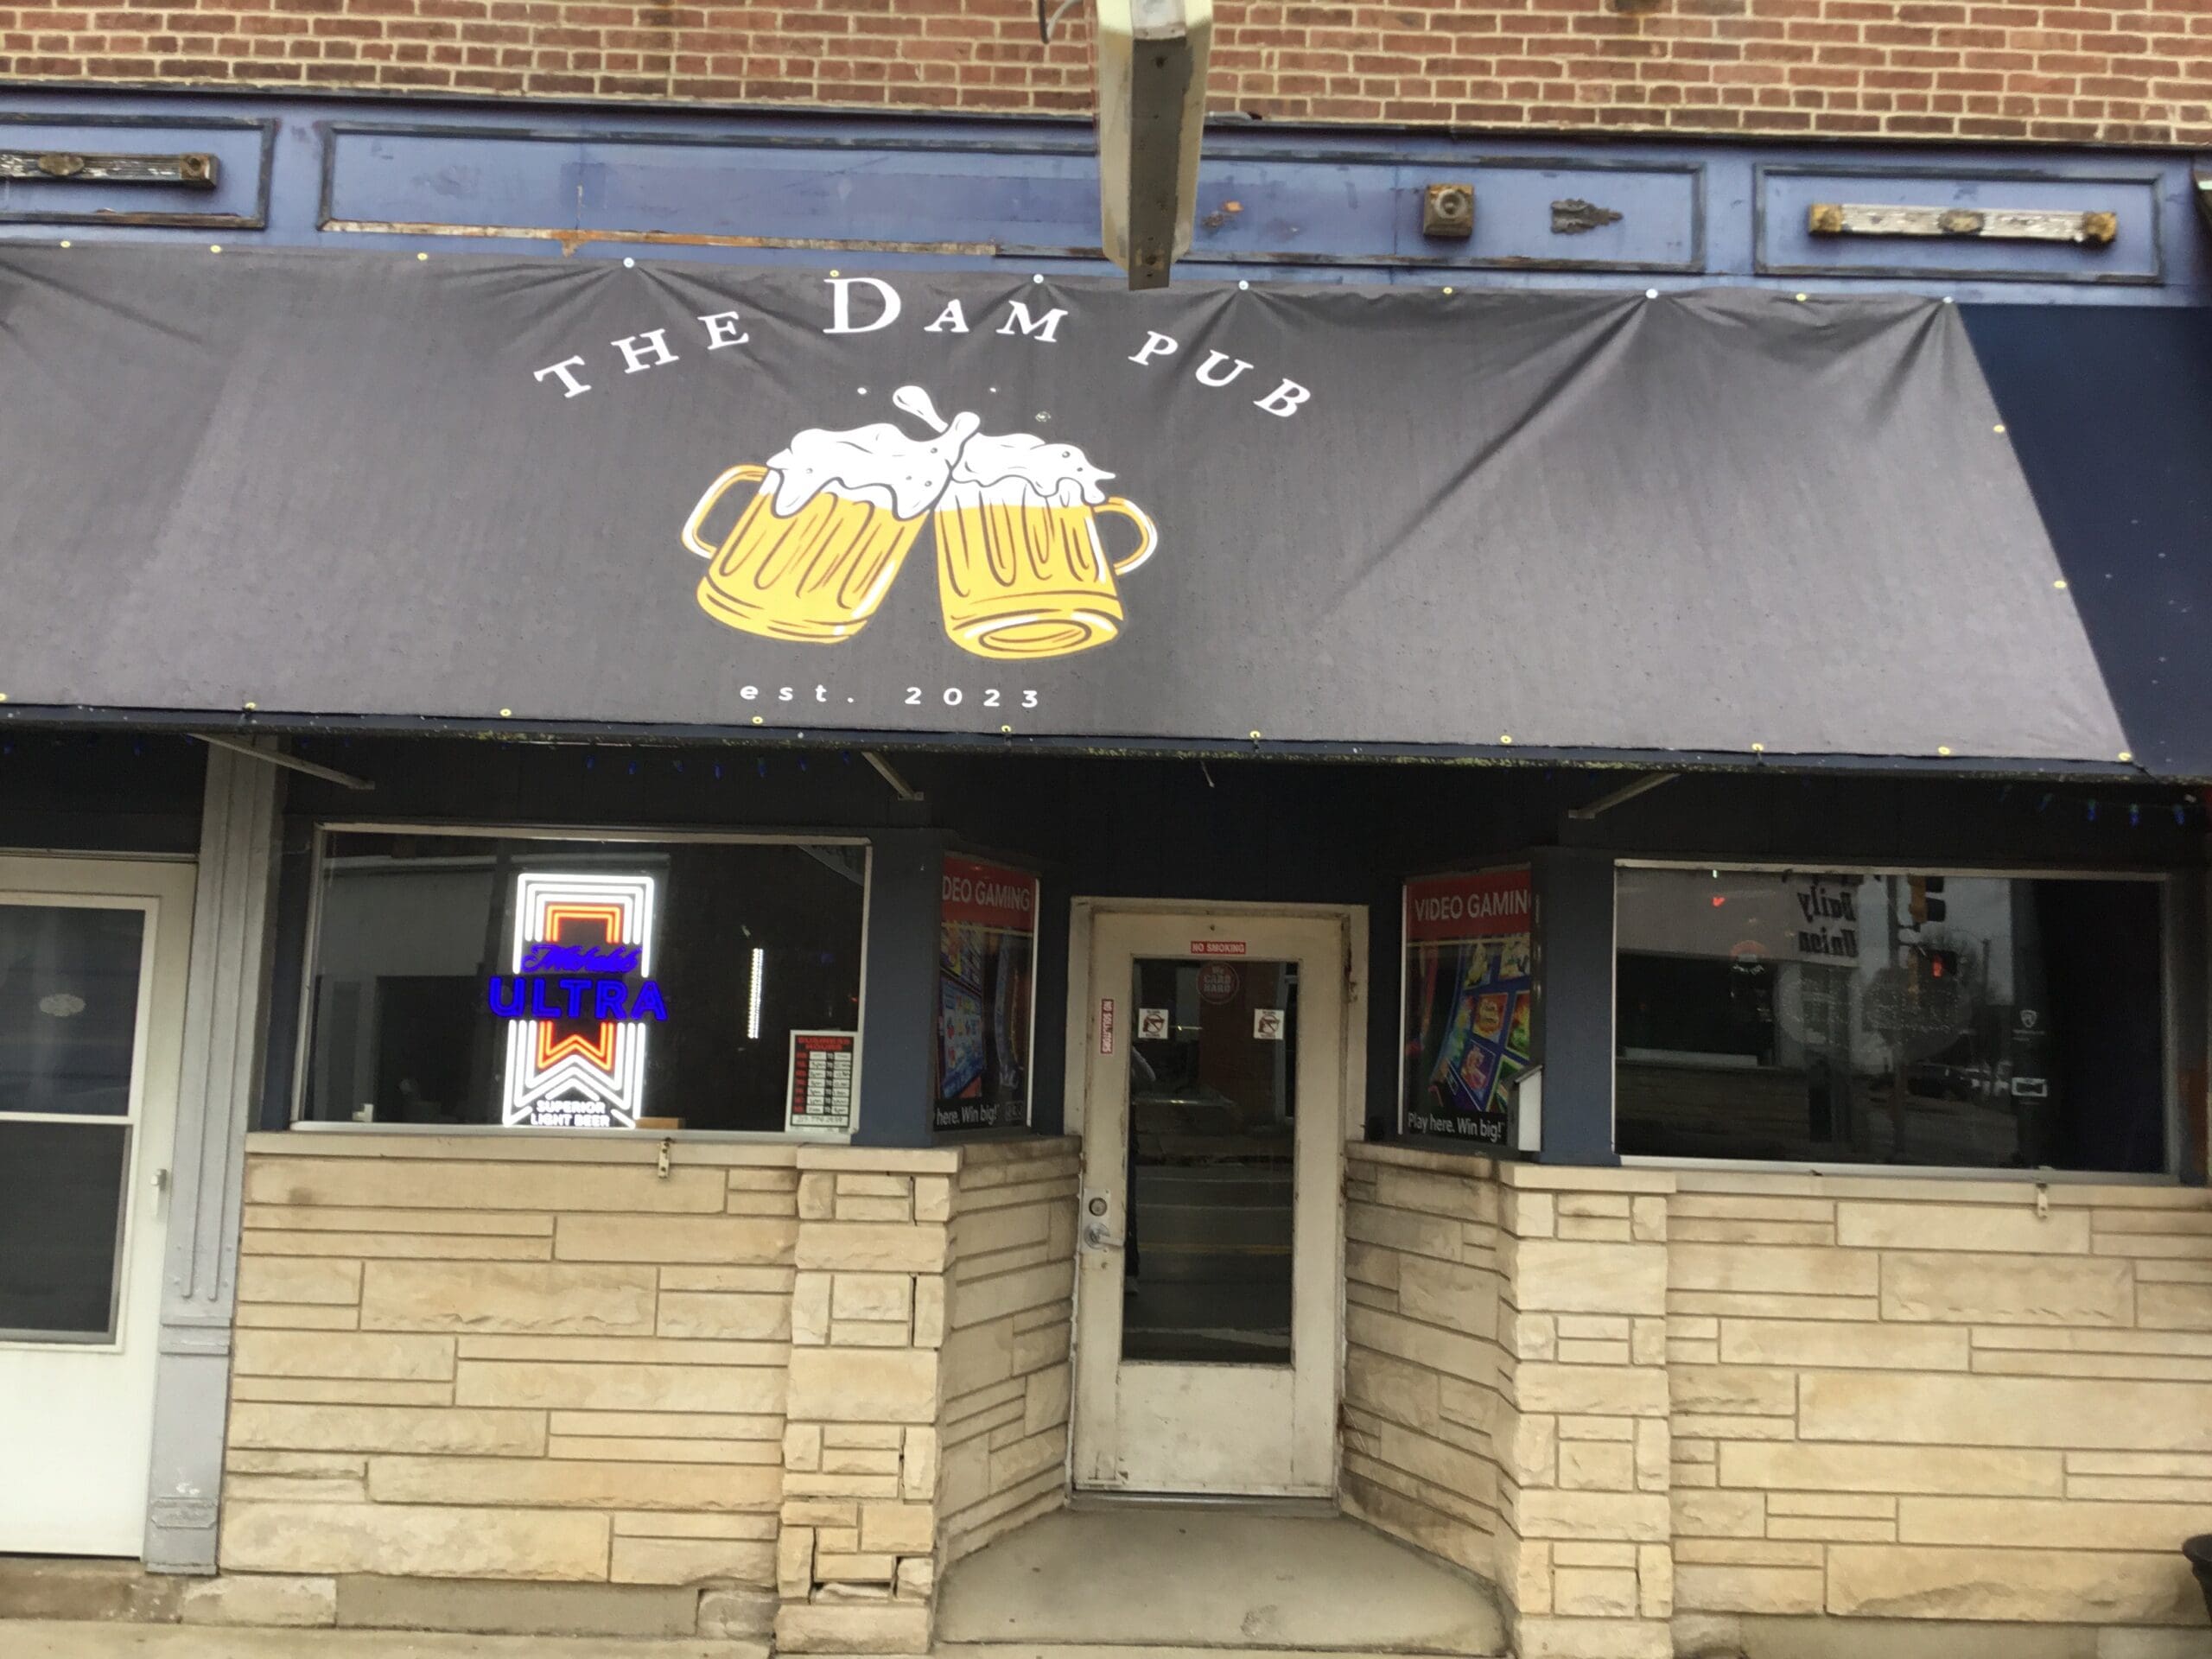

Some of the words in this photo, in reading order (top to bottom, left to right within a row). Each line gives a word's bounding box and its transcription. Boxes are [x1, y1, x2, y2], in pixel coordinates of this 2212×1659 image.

[534, 311, 748, 397] THE
[823, 278, 1067, 342] DAM
[1129, 331, 1310, 416] PUB
[741, 685, 853, 702] est.
[906, 687, 1037, 708] 2023
[976, 880, 1030, 912] GAMING
[1414, 895, 1463, 921] VIDEO
[1467, 889, 1531, 918] GAMIN
[1192, 944, 1204, 952] NO
[1207, 944, 1244, 953] SMOKING
[488, 976, 668, 1021] ULTRA
[1103, 1001, 1113, 1011] NO
[537, 1100, 606, 1114] SUPERIOR
[961, 1106, 978, 1123] Win
[531, 1113, 572, 1126] LIGHT
[574, 1115, 610, 1127] BEER
[1408, 1112, 1429, 1134] Play
[1430, 1113, 1456, 1133] here.
[1457, 1116, 1478, 1135] Win
[1480, 1117, 1502, 1143] big!
